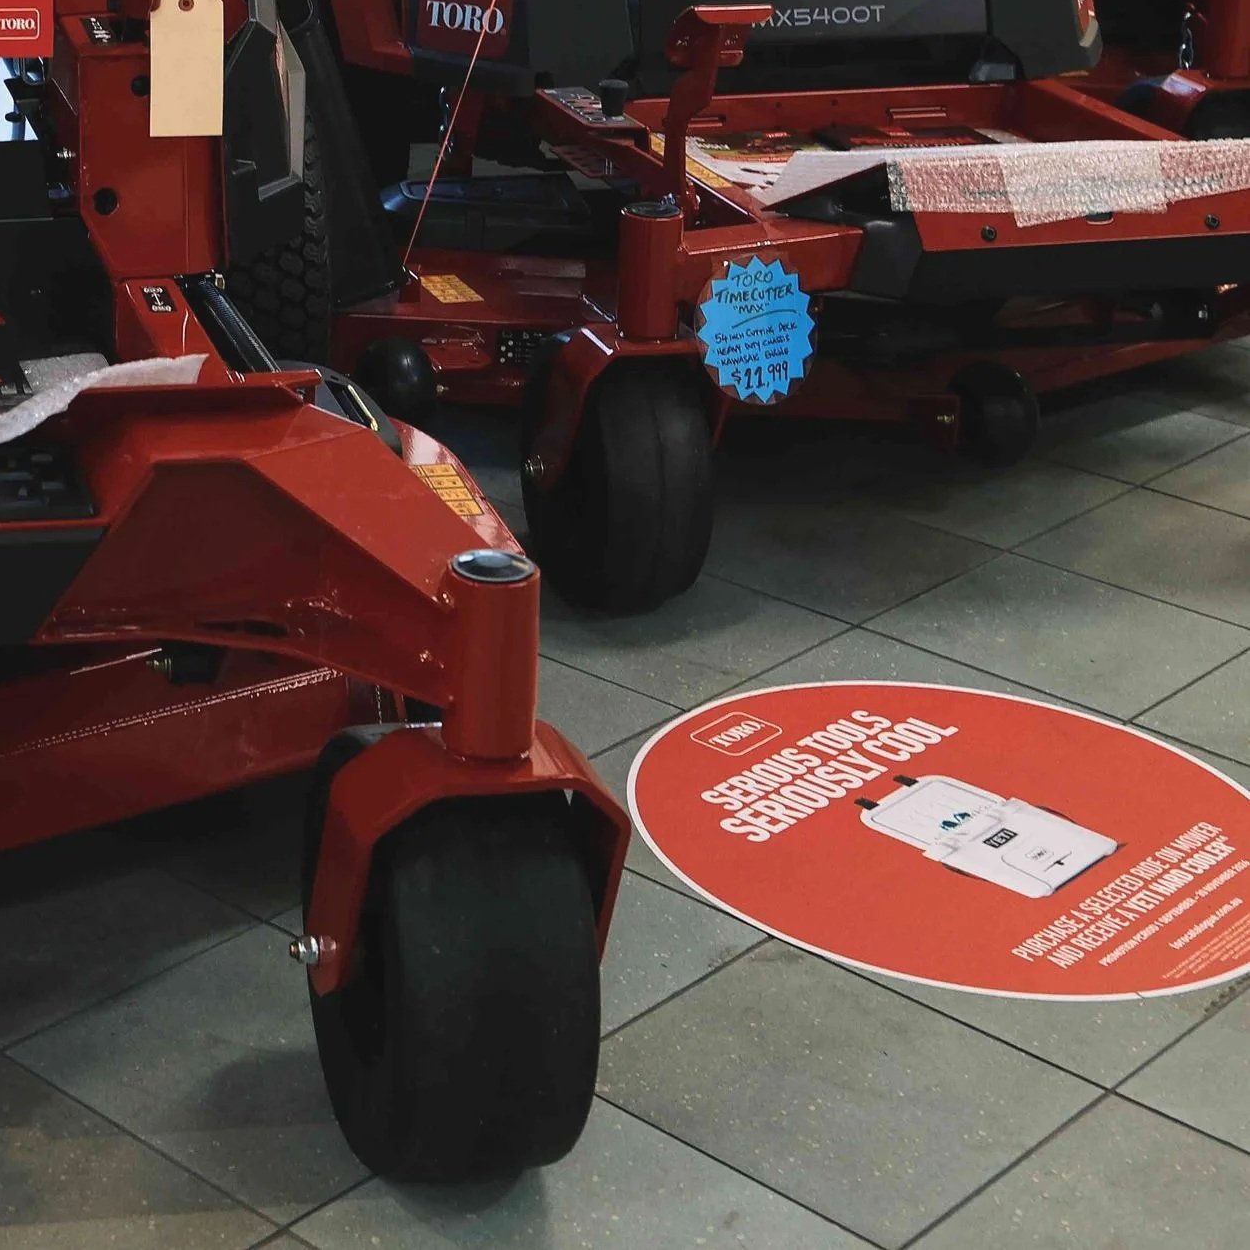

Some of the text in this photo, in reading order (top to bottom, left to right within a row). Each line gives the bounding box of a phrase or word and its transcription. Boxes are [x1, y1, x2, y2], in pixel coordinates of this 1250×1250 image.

[426, 0, 504, 34] TORO
[731, 270, 774, 287] TORO
[714, 283, 794, 304] TIMECUTTER
[714, 332, 728, 345] 54
[745, 327, 775, 340] CUTTING
[778, 321, 797, 332] DECK
[744, 341, 761, 351] DUTY
[731, 361, 789, 390] $11,999
[708, 720, 762, 748] TORO
[701, 710, 892, 812] SERIOUS TOOLS
[719, 717, 959, 843] SERIOUSLY COOL
[985, 829, 1016, 847] YETI
[1011, 821, 1223, 962] PURCHASE A SELECTED RIDE ON MOWER
[1148, 868, 1195, 897] HARD
[1117, 908, 1141, 921] A
[1122, 890, 1165, 913] YETI
[1070, 914, 1130, 952] RECEIVE
[1047, 937, 1086, 970] AND
